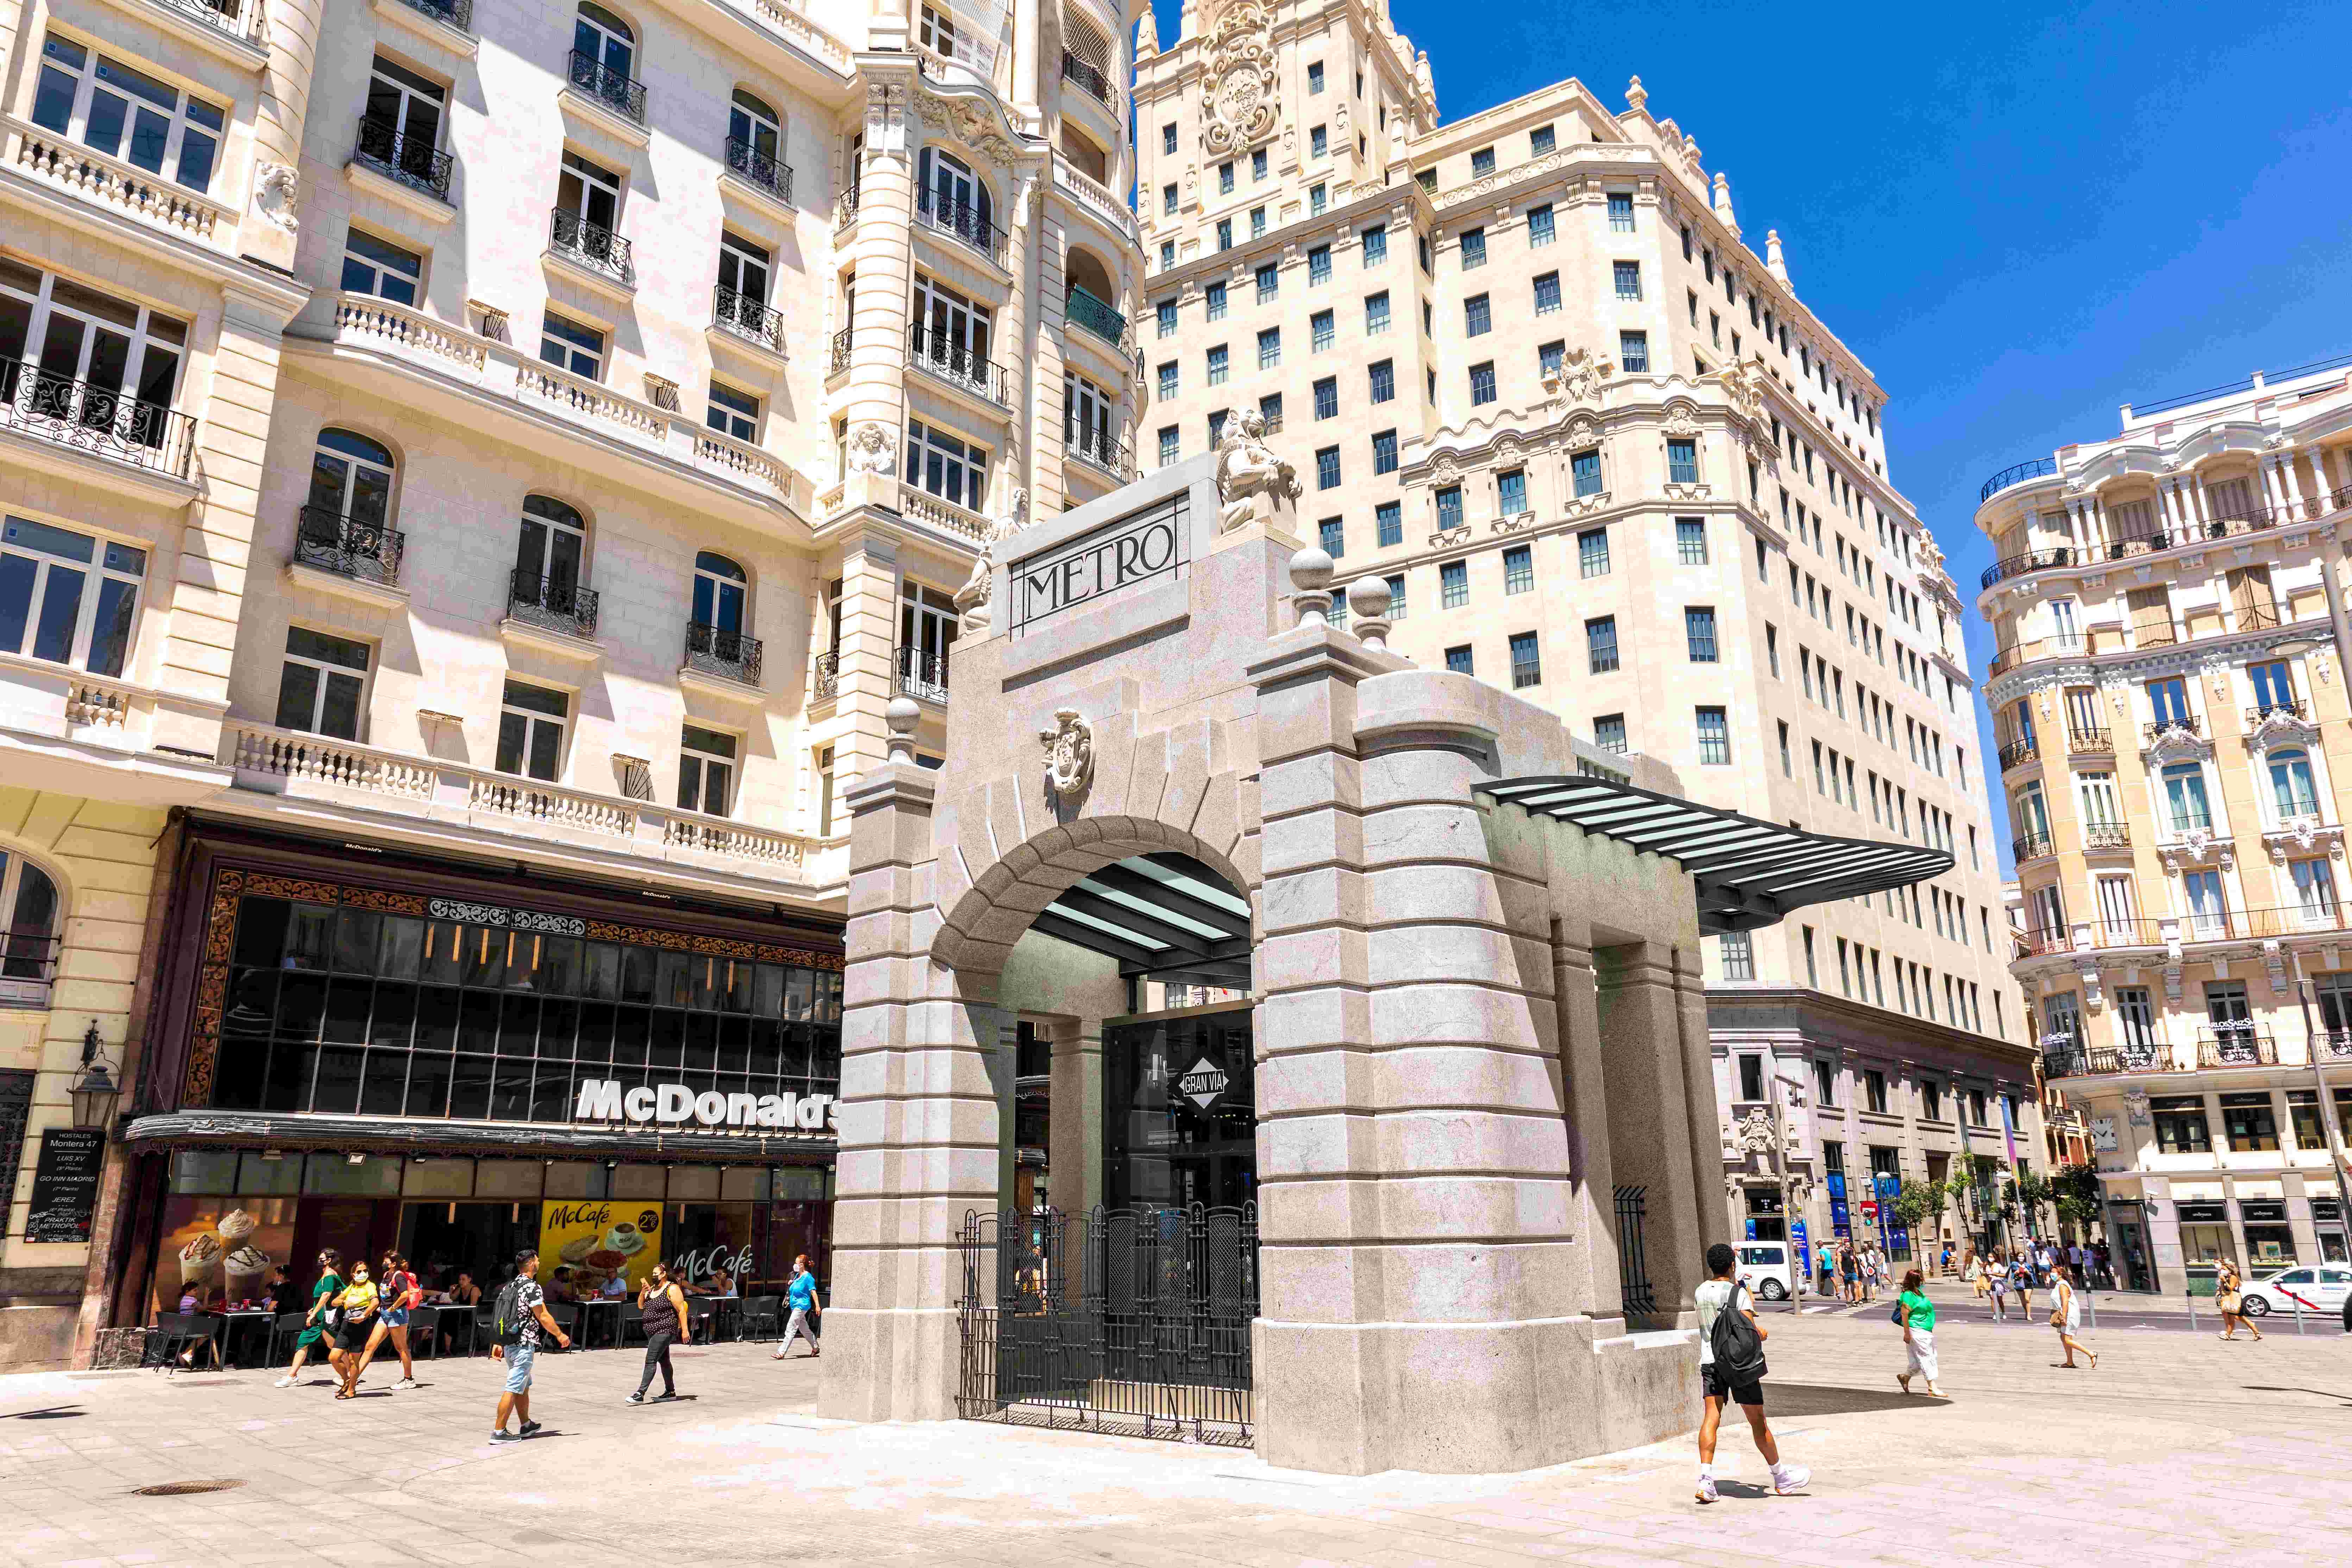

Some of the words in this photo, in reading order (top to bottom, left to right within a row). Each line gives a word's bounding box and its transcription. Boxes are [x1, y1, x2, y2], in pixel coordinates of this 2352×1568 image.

[1026, 524, 1174, 619] METRO
[345, 844, 382, 852] McDonald's
[1185, 1075, 1207, 1093] GRAN
[1209, 1071, 1222, 1090] VÍA
[548, 1203, 611, 1230] McCafé
